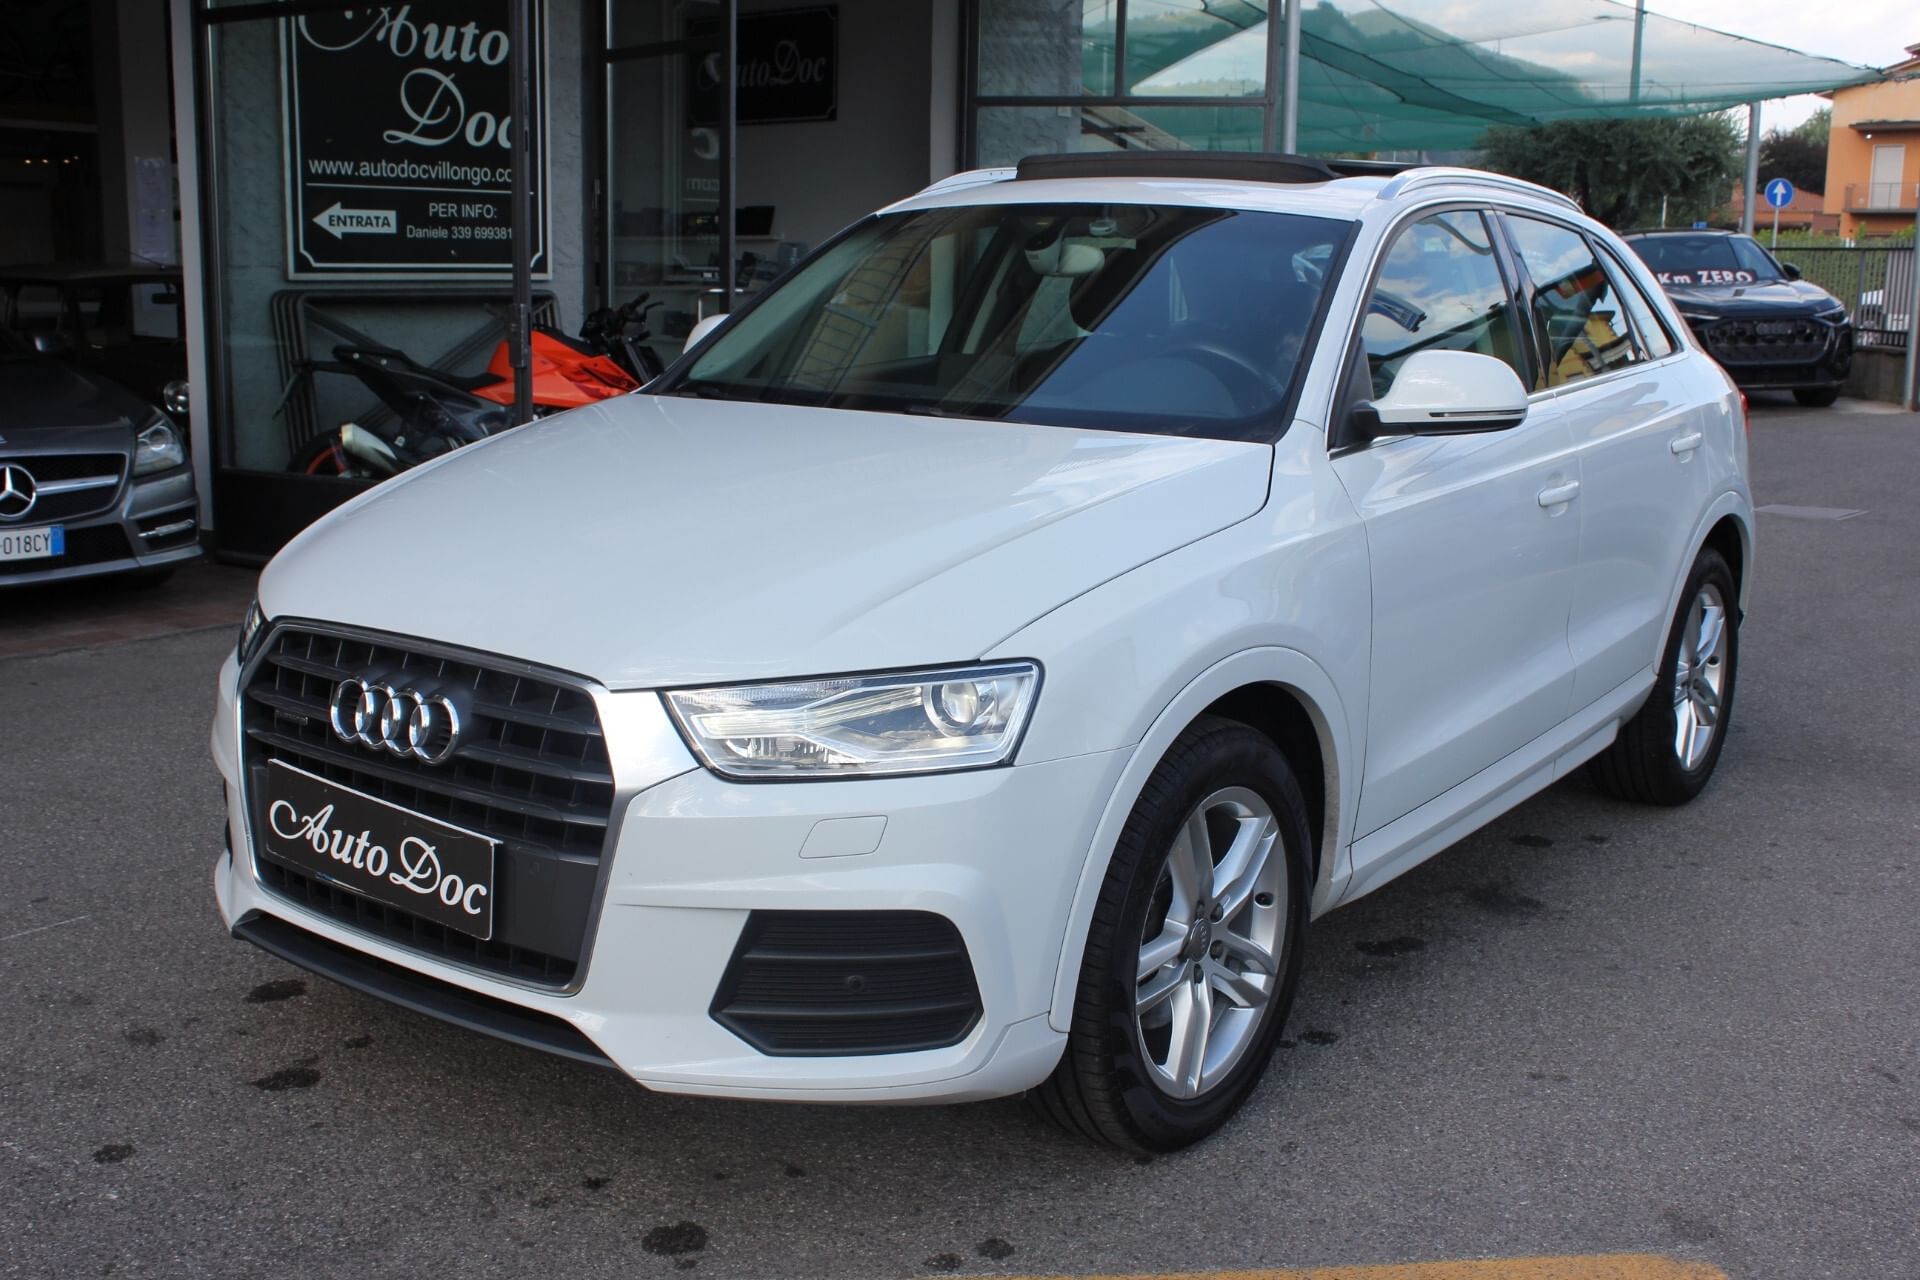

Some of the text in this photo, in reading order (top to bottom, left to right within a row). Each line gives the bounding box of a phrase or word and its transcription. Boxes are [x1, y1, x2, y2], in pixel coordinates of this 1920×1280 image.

[769, 39, 826, 85] Doc
[308, 159, 512, 186] www.autodocvillongo.co
[429, 202, 498, 219] PER INFO:
[328, 214, 391, 228] ENTRATA
[406, 225, 512, 240] Daniele 339 699381
[1657, 270, 1753, 286] Km ZERO
[0, 533, 50, 555] 018CY
[269, 800, 488, 916] Auto Doc
